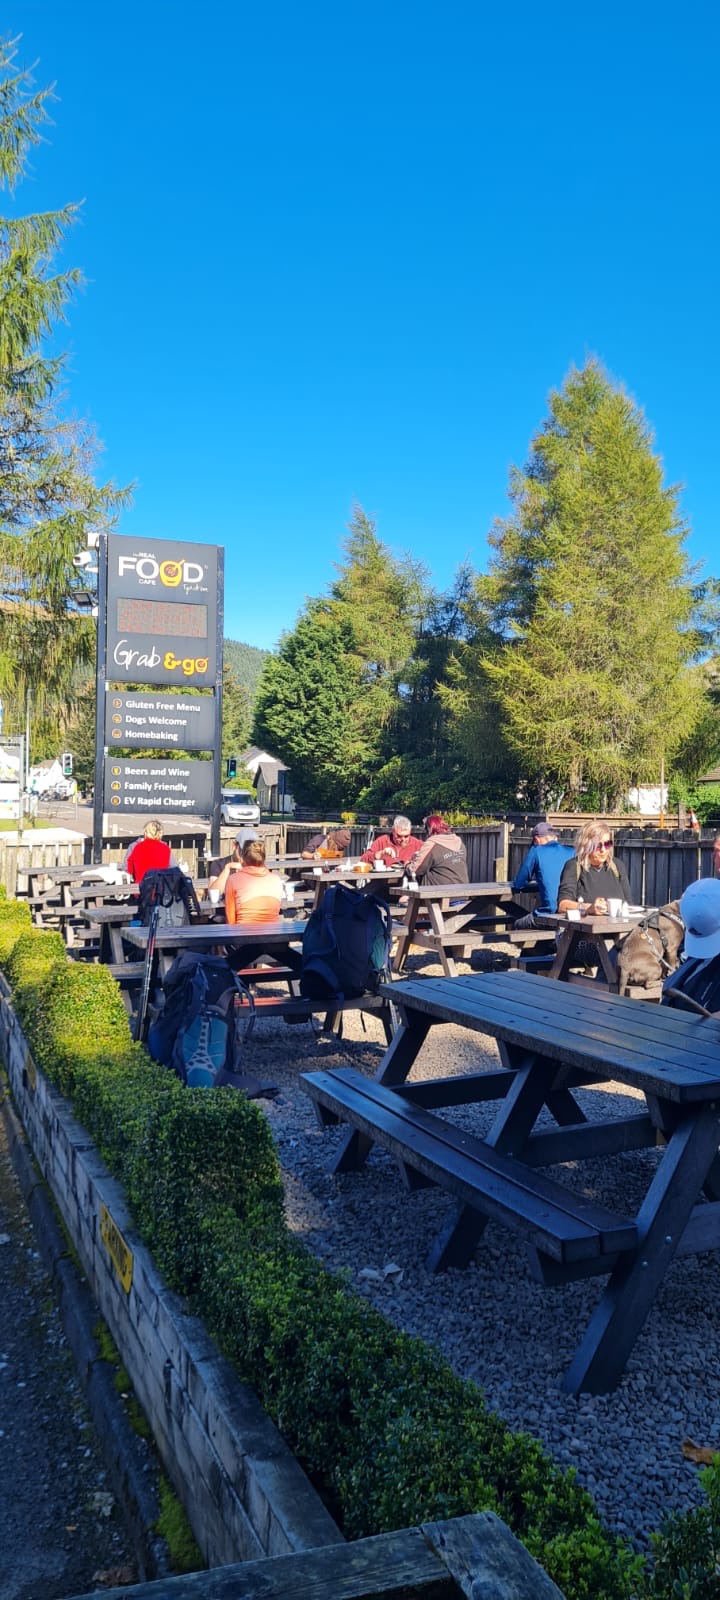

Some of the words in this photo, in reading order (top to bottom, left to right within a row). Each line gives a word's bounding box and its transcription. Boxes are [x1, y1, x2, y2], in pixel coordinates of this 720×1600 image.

[118, 555, 204, 587] FOOD
[138, 578, 156, 586] CAFE
[113, 639, 160, 671] Grab
[125, 700, 154, 709] Gluten
[156, 701, 174, 710] Free
[176, 703, 201, 712] Menu
[125, 715, 146, 725] Dogs
[148, 716, 188, 726] Welcome
[125, 730, 179, 742] Homebaking
[124, 767, 149, 775] Beers
[150, 768, 166, 776] and
[168, 768, 190, 777] Wine
[124, 781, 152, 792] Family
[154, 782, 188, 793] Friendly
[124, 796, 136, 804] EV
[137, 797, 162, 807] Rapid
[163, 797, 196, 808] Charger
